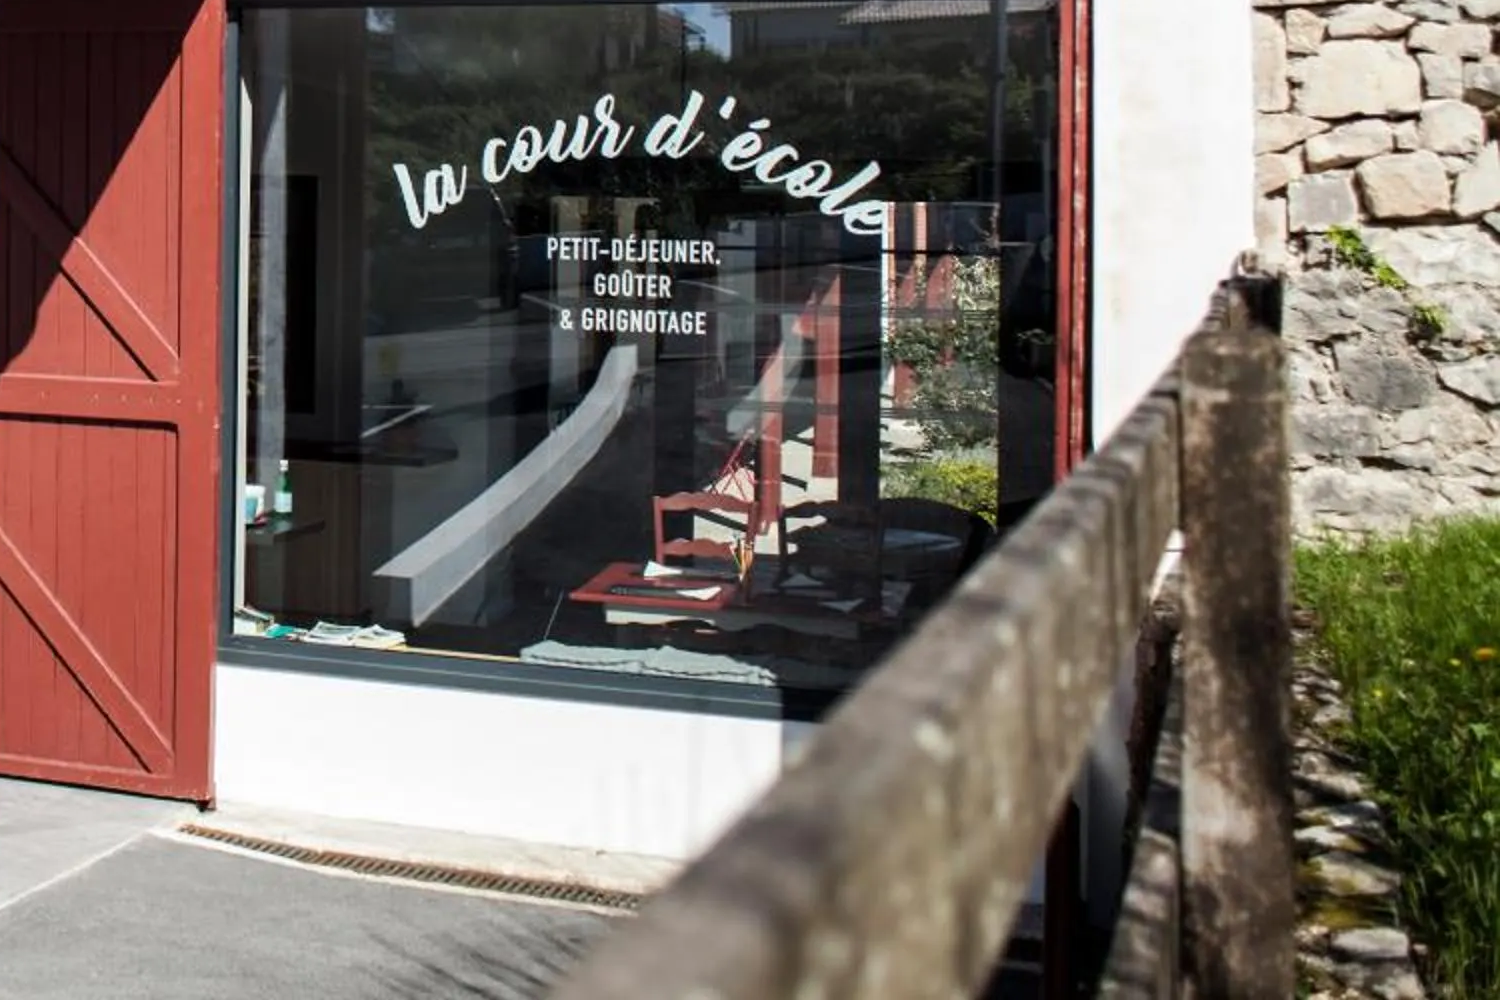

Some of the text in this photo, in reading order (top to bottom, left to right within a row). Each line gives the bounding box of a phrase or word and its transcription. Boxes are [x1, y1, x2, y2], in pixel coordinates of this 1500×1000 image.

[392, 89, 888, 235] la cour d'école
[594, 269, 672, 298] GOÛTER
[559, 307, 707, 335] & GRIGNOTAGE
